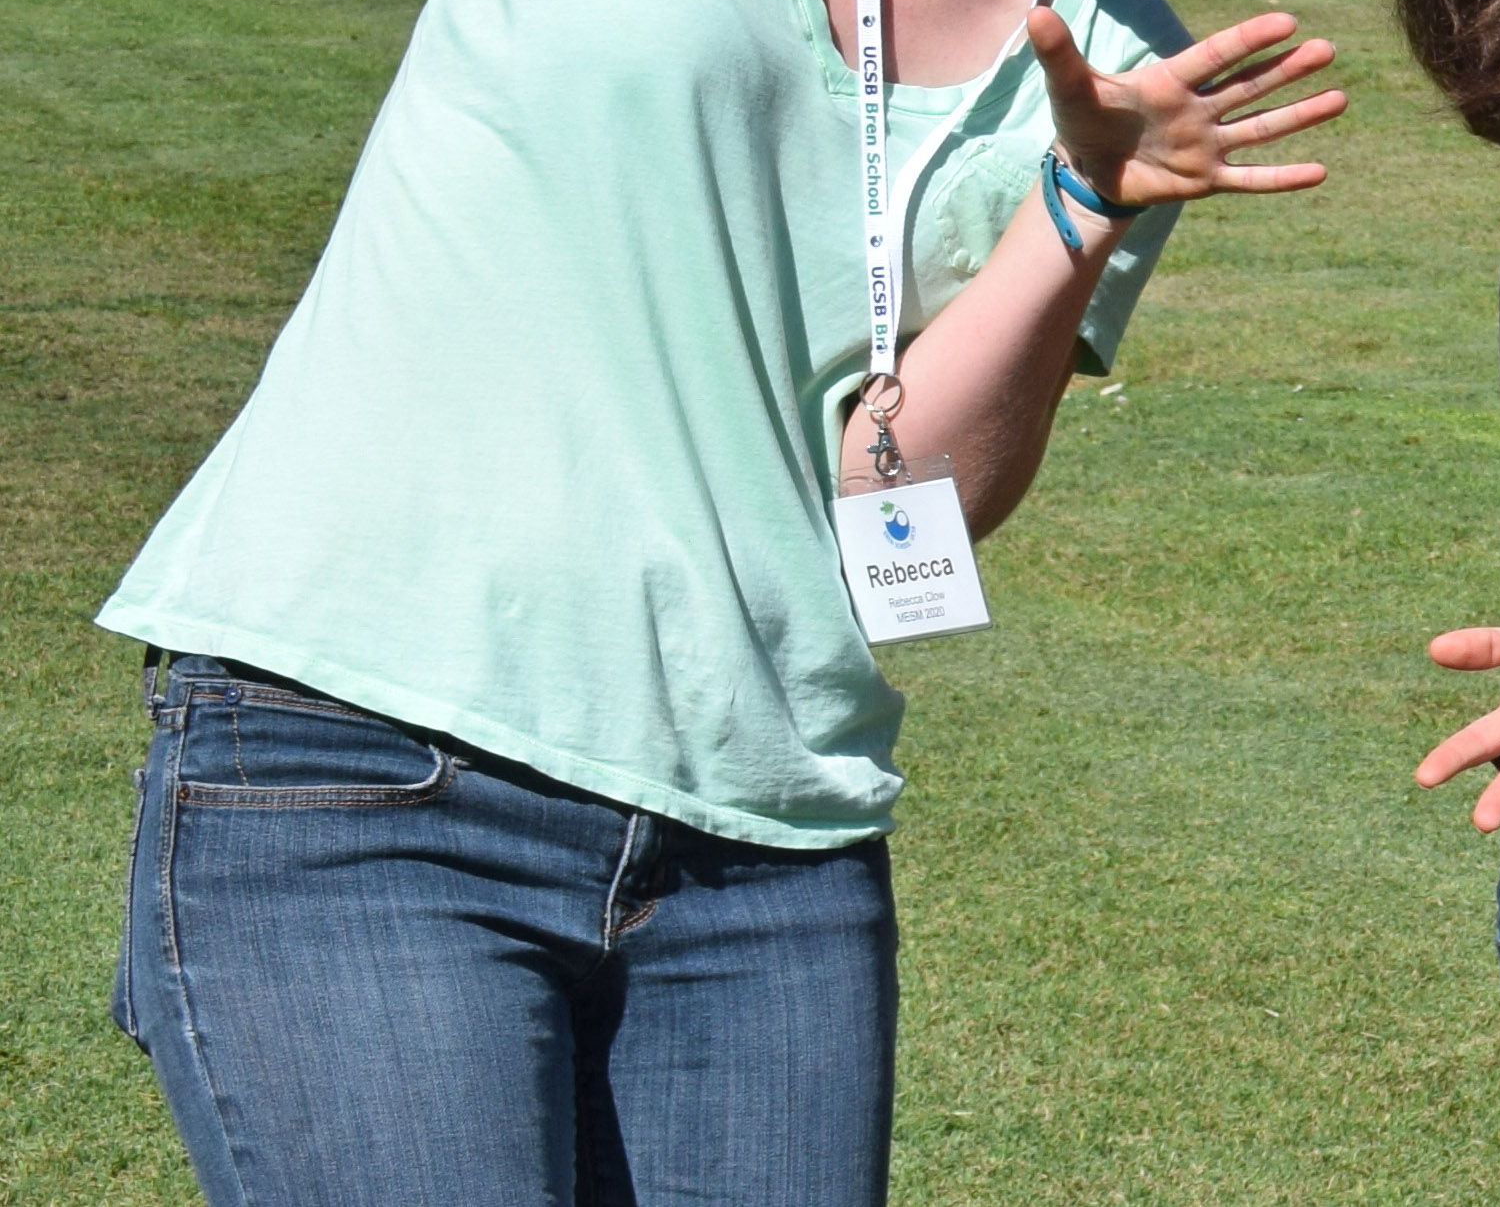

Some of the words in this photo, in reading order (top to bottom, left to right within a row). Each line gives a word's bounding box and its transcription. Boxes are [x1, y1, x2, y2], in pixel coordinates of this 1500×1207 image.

[864, 46, 878, 96] UCSB
[865, 102, 880, 146] Bren
[867, 153, 883, 216] School
[871, 266, 888, 317] UCSB
[866, 556, 955, 588] Rebecca
[888, 593, 924, 609] Rebecca
[926, 606, 946, 620] 2020
